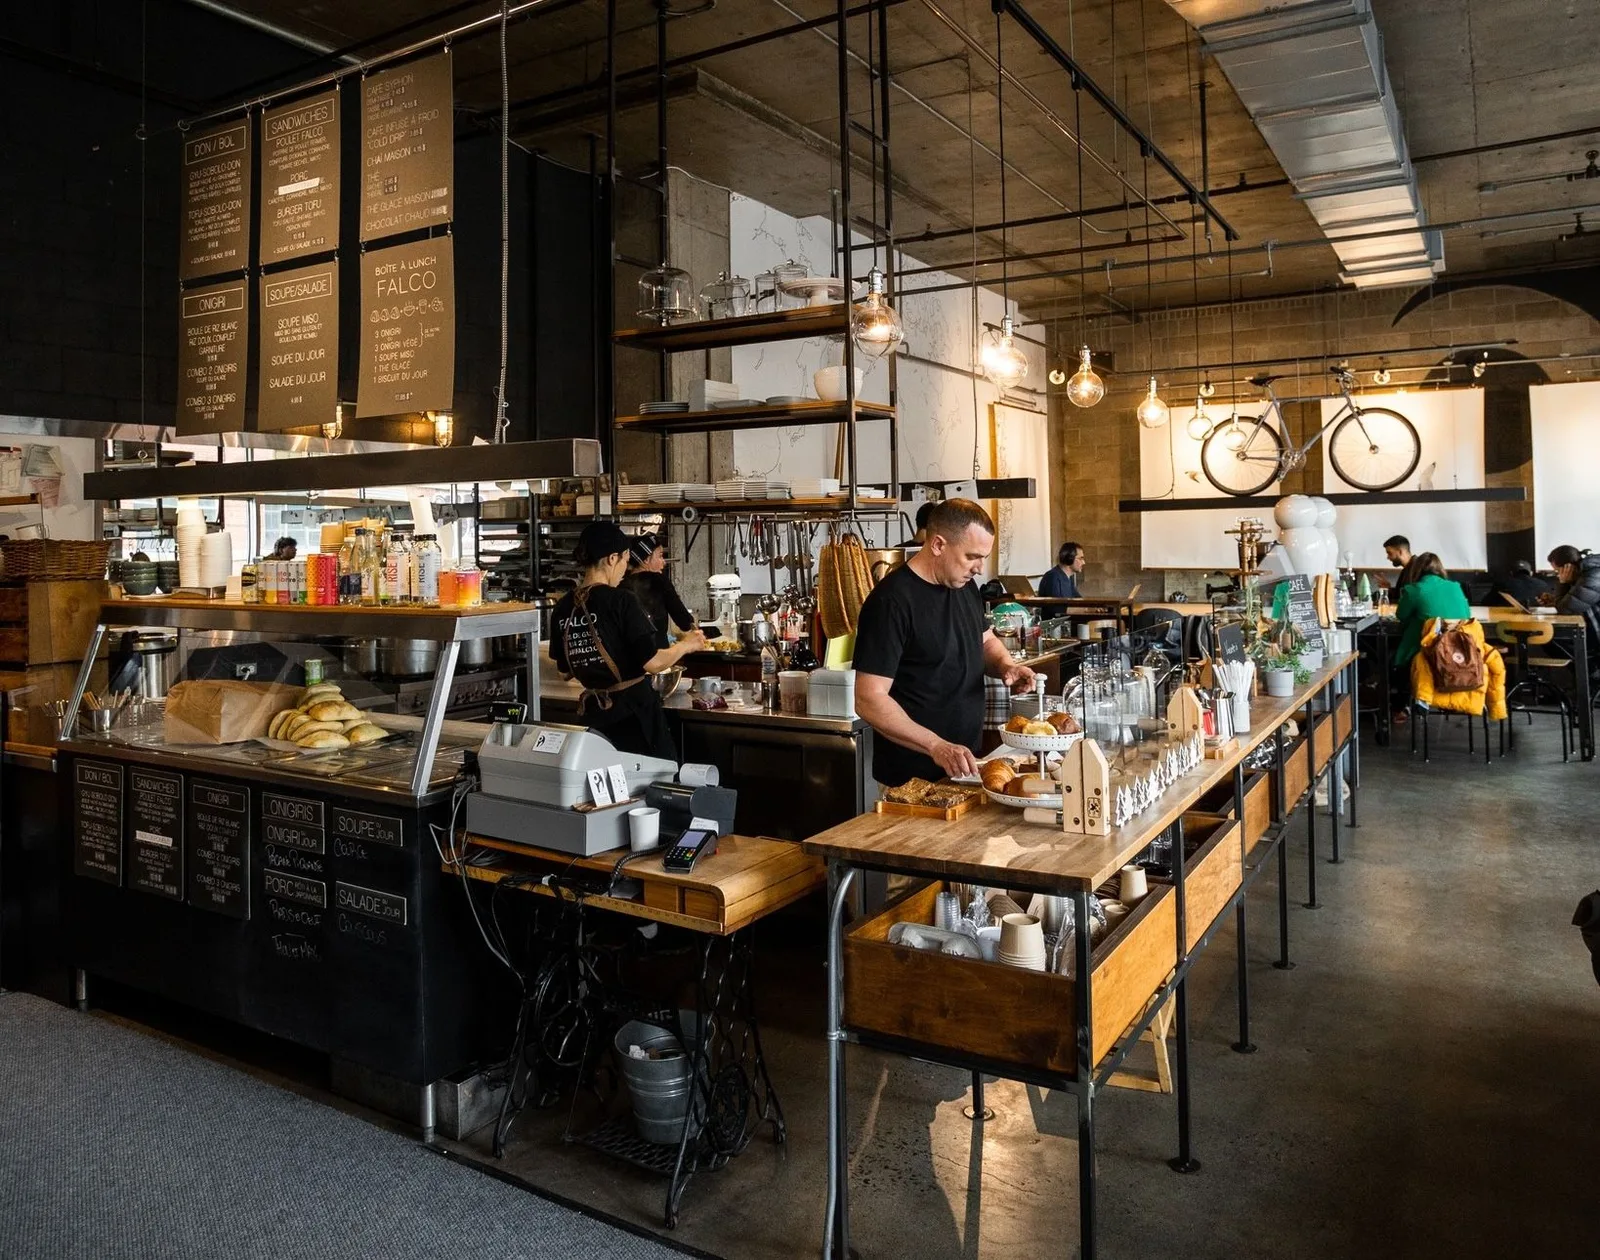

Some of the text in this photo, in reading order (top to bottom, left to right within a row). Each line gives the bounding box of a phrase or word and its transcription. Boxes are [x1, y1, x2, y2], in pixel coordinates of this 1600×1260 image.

[272, 106, 327, 134] SANDWICHES
[276, 126, 323, 148] POULET FALCO
[194, 142, 211, 157] DON
[219, 136, 234, 149] BOL
[384, 146, 410, 162] MAISON
[404, 192, 430, 205] MAISON
[277, 199, 322, 218] BURGER TOFU
[366, 215, 403, 231] CHOCOLAT
[375, 256, 436, 276] BOÎTE À LUNCH
[270, 280, 327, 301] SOUPE/SALADE
[377, 271, 436, 297] FALCO
[199, 296, 226, 311] ONIGIRI
[188, 327, 203, 336] BOULE
[204, 325, 211, 333] DE
[221, 321, 238, 331] BLANC
[278, 313, 319, 329] SOUPE MISO
[198, 336, 211, 345] DOUX
[212, 332, 236, 342] COMPLET
[381, 327, 401, 337] ONIGIRI
[199, 344, 225, 355] GARNITURE
[271, 349, 324, 366] SOUPE DU JOUR
[379, 352, 398, 362] SOUPE
[400, 350, 414, 358] MISO
[187, 367, 207, 378] COMBO
[209, 366, 213, 375] 2
[269, 371, 326, 388] SALADE DU JOUR
[378, 373, 400, 383] BISCUIT
[412, 370, 427, 379] JOUR
[186, 397, 206, 406] COMBO
[207, 396, 211, 404] 3
[1288, 576, 1305, 591] CAFÉ
[559, 613, 598, 630] FALCO
[84, 770, 113, 784] DON BOL
[136, 777, 174, 794] SANDWICHES
[207, 792, 229, 805] ONIGIRI
[270, 799, 313, 821] ONIGIRIS
[339, 816, 374, 837] SOUPE
[376, 830, 394, 840] JOUR
[267, 825, 300, 844] ONIGIRI
[301, 837, 317, 848] JOUR
[265, 875, 293, 896] PORC
[339, 889, 380, 914] SALADE
[383, 907, 400, 918] JOUR
